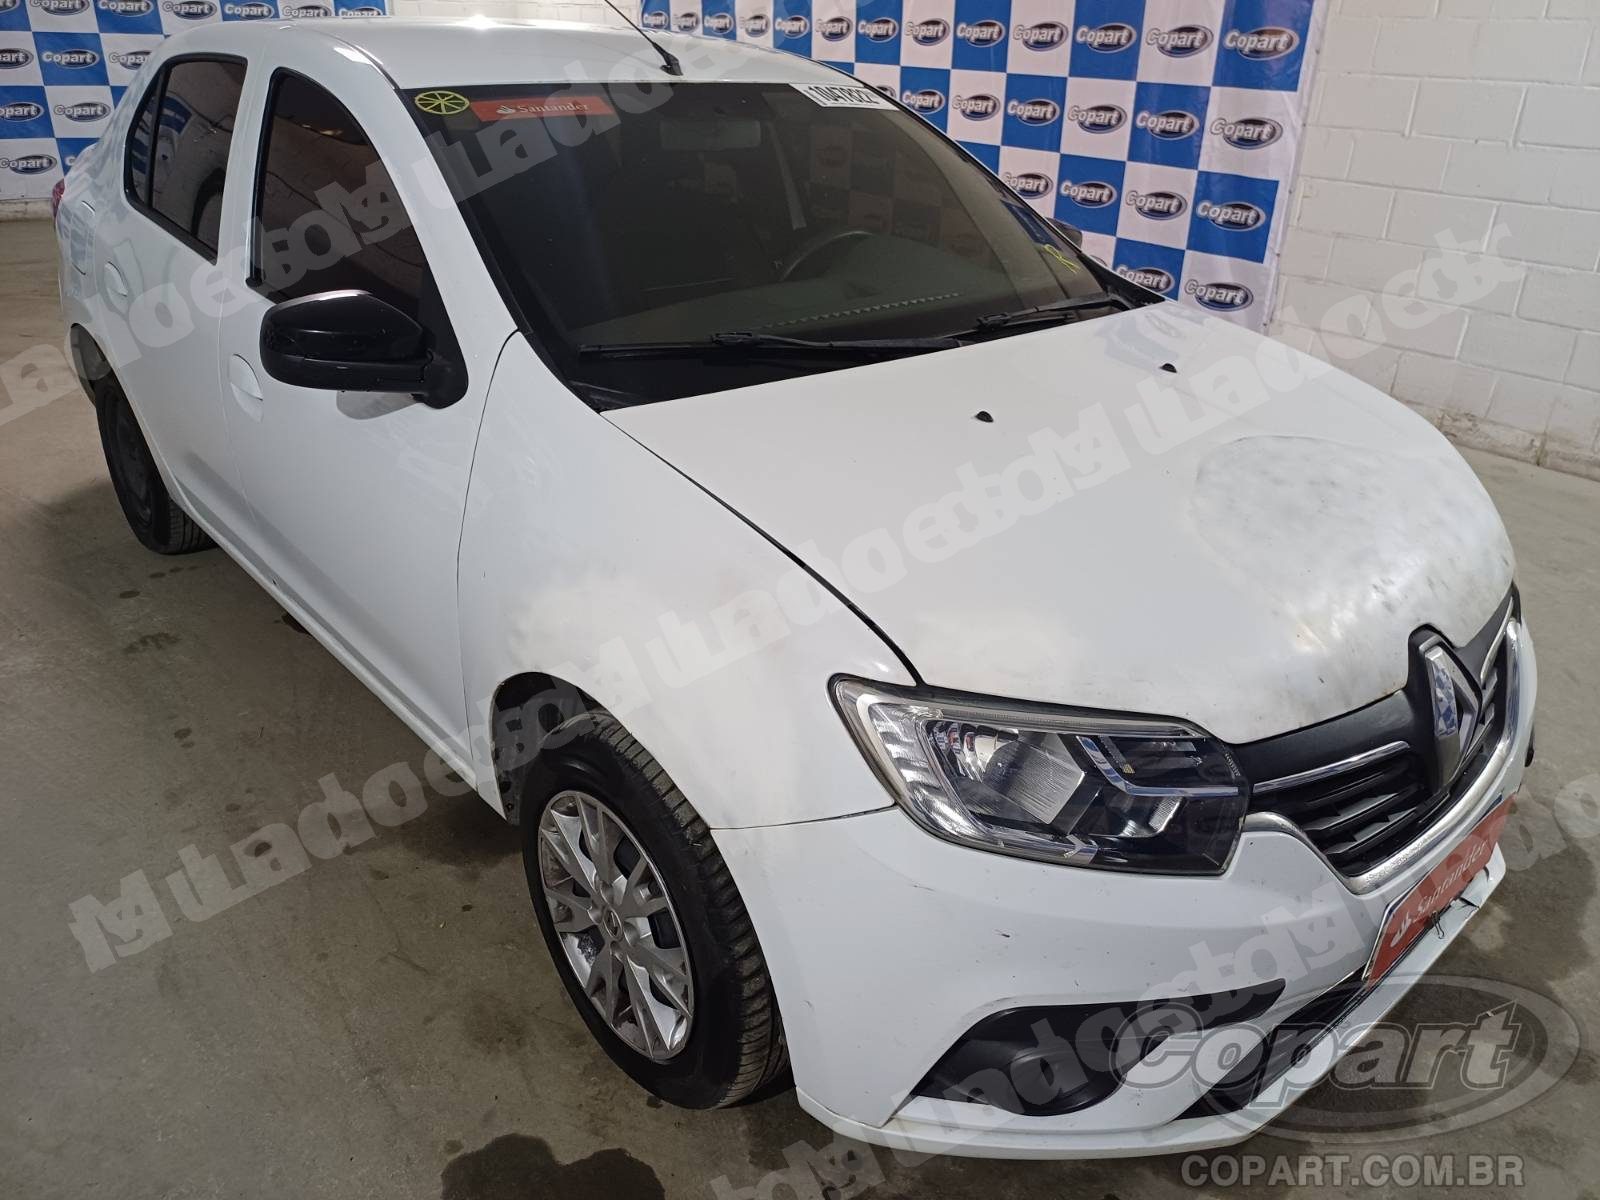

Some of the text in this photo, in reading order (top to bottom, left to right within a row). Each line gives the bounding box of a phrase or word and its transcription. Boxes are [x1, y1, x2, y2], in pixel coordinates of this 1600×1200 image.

[30, 0, 82, 10] Copart
[99, 0, 148, 11] Copart
[163, 2, 209, 14] Copart
[224, 4, 269, 17] Copart
[283, 6, 325, 17] Copart
[703, 15, 731, 30] Copart
[775, 17, 805, 33] Copart
[816, 19, 848, 35] Copart
[858, 20, 895, 37] Copart
[905, 22, 944, 39] Copart
[956, 22, 1000, 42] Copart
[1014, 25, 1060, 43] Copart
[1076, 26, 1129, 47] Copart
[1147, 28, 1204, 50] Copart
[1225, 29, 1289, 52] Copart
[42, 51, 94, 64] Copart
[518, 102, 588, 112] Santander
[902, 90, 940, 108] Copart
[952, 95, 994, 114] Copart
[0, 107, 37, 118] opart
[54, 104, 103, 117] Copart
[1007, 100, 1054, 120] Copart
[1068, 105, 1119, 127] Copart
[1136, 111, 1191, 133] Copart
[1210, 117, 1272, 141] Copart
[0, 157, 49, 170] Copart
[1004, 172, 1047, 192] Copart
[1061, 180, 1110, 202] Copart
[1126, 190, 1179, 213] Copart
[1197, 201, 1257, 226] Copart
[1185, 279, 1246, 305] Copart
[1417, 838, 1489, 912] Santander
